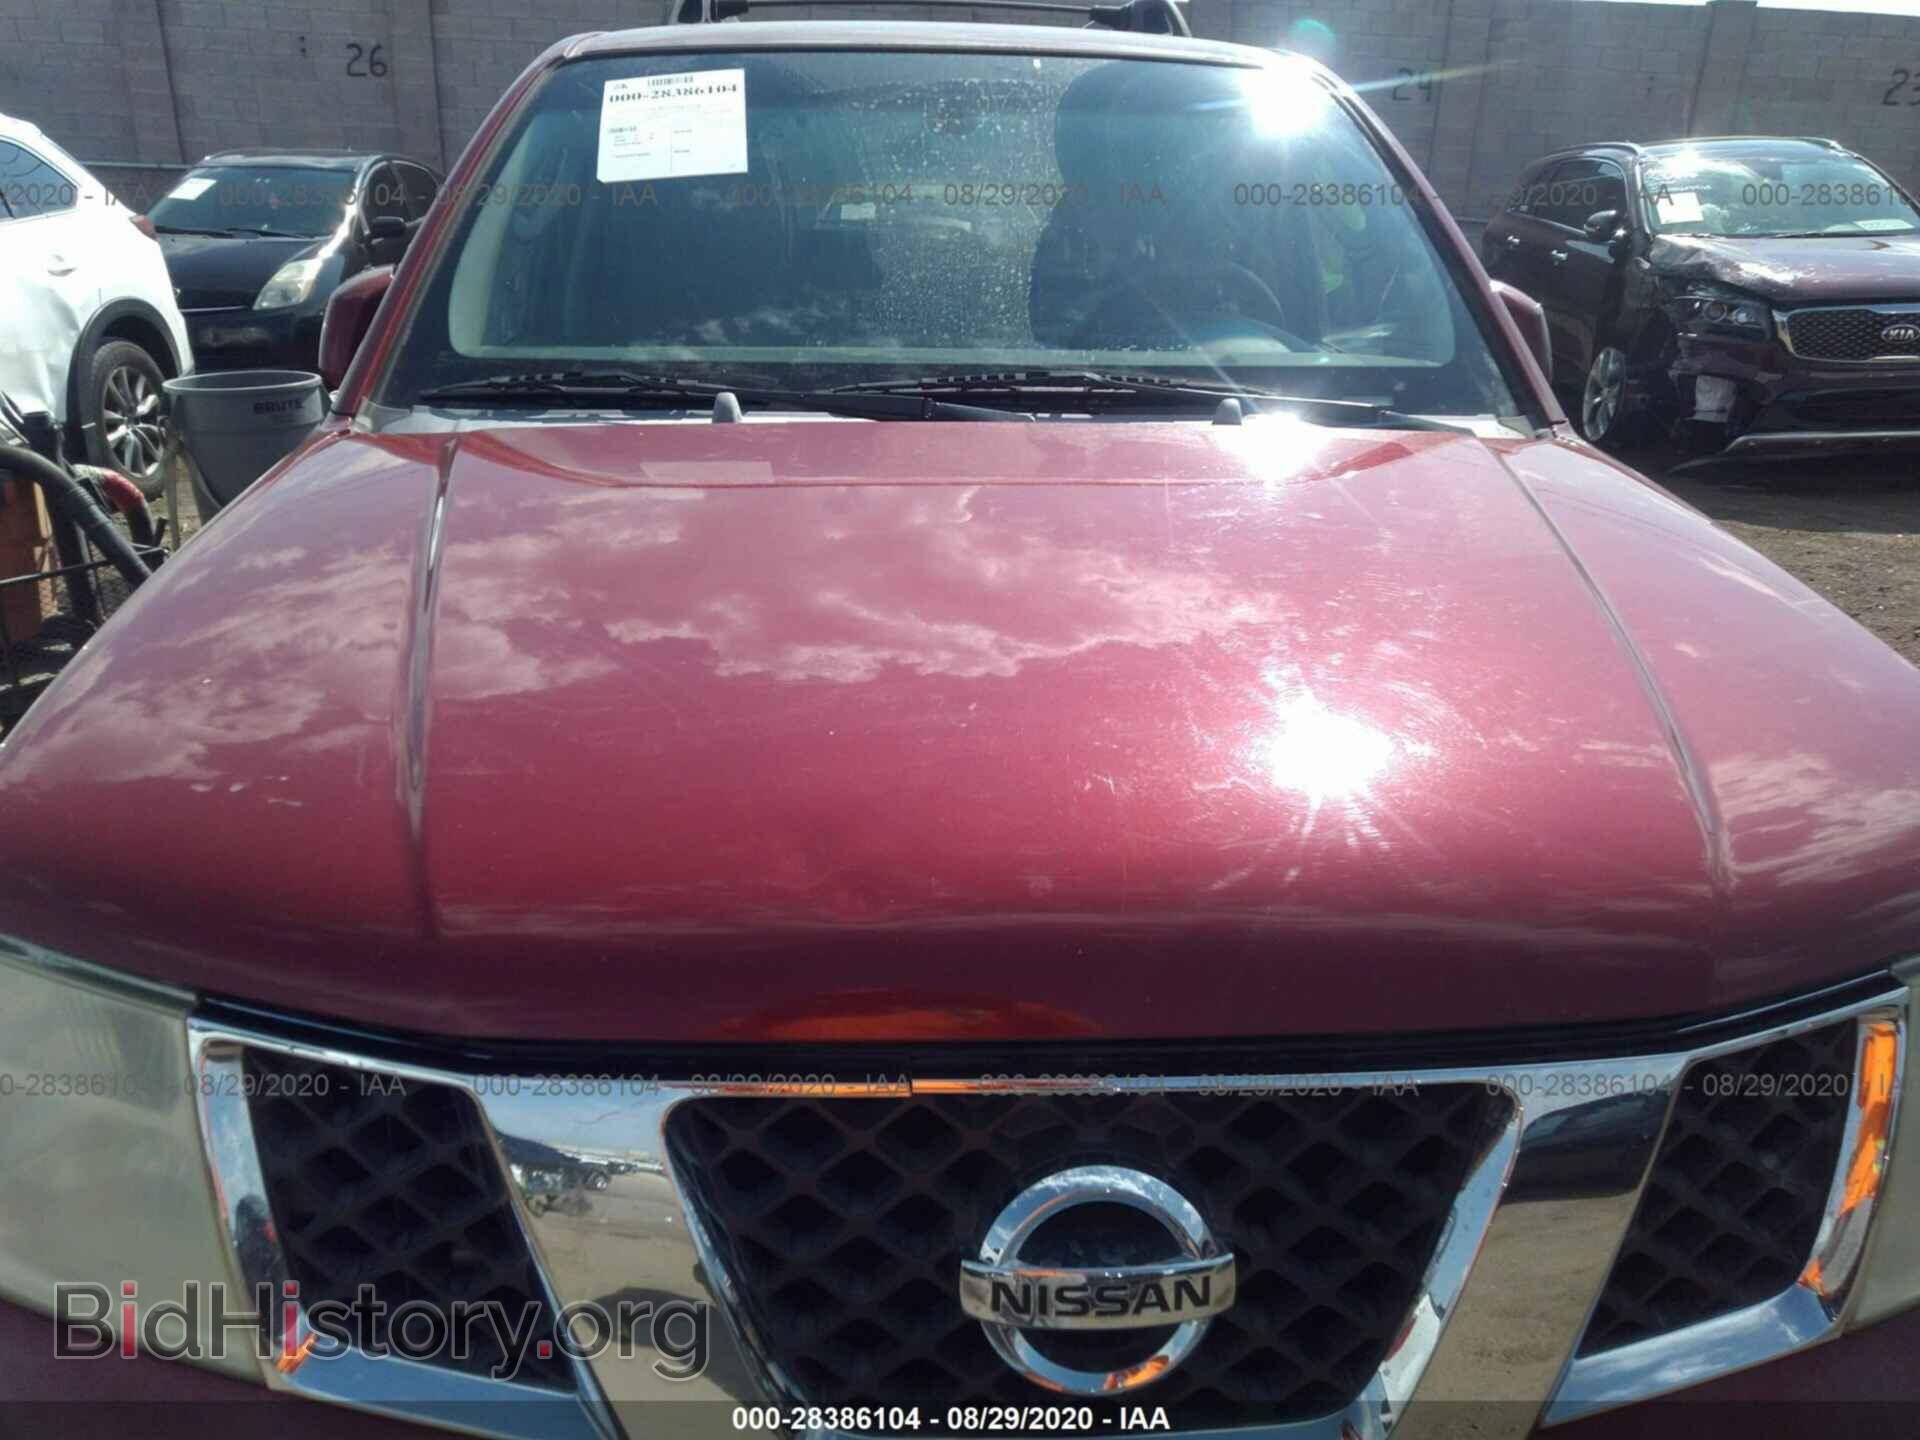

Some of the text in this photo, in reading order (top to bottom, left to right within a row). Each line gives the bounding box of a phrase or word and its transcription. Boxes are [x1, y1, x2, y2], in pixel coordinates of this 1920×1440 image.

[346, 43, 388, 77] 26
[1392, 66, 1432, 102] 24
[1889, 328, 1915, 339] KIA
[991, 1275, 1212, 1318] NISSAN
